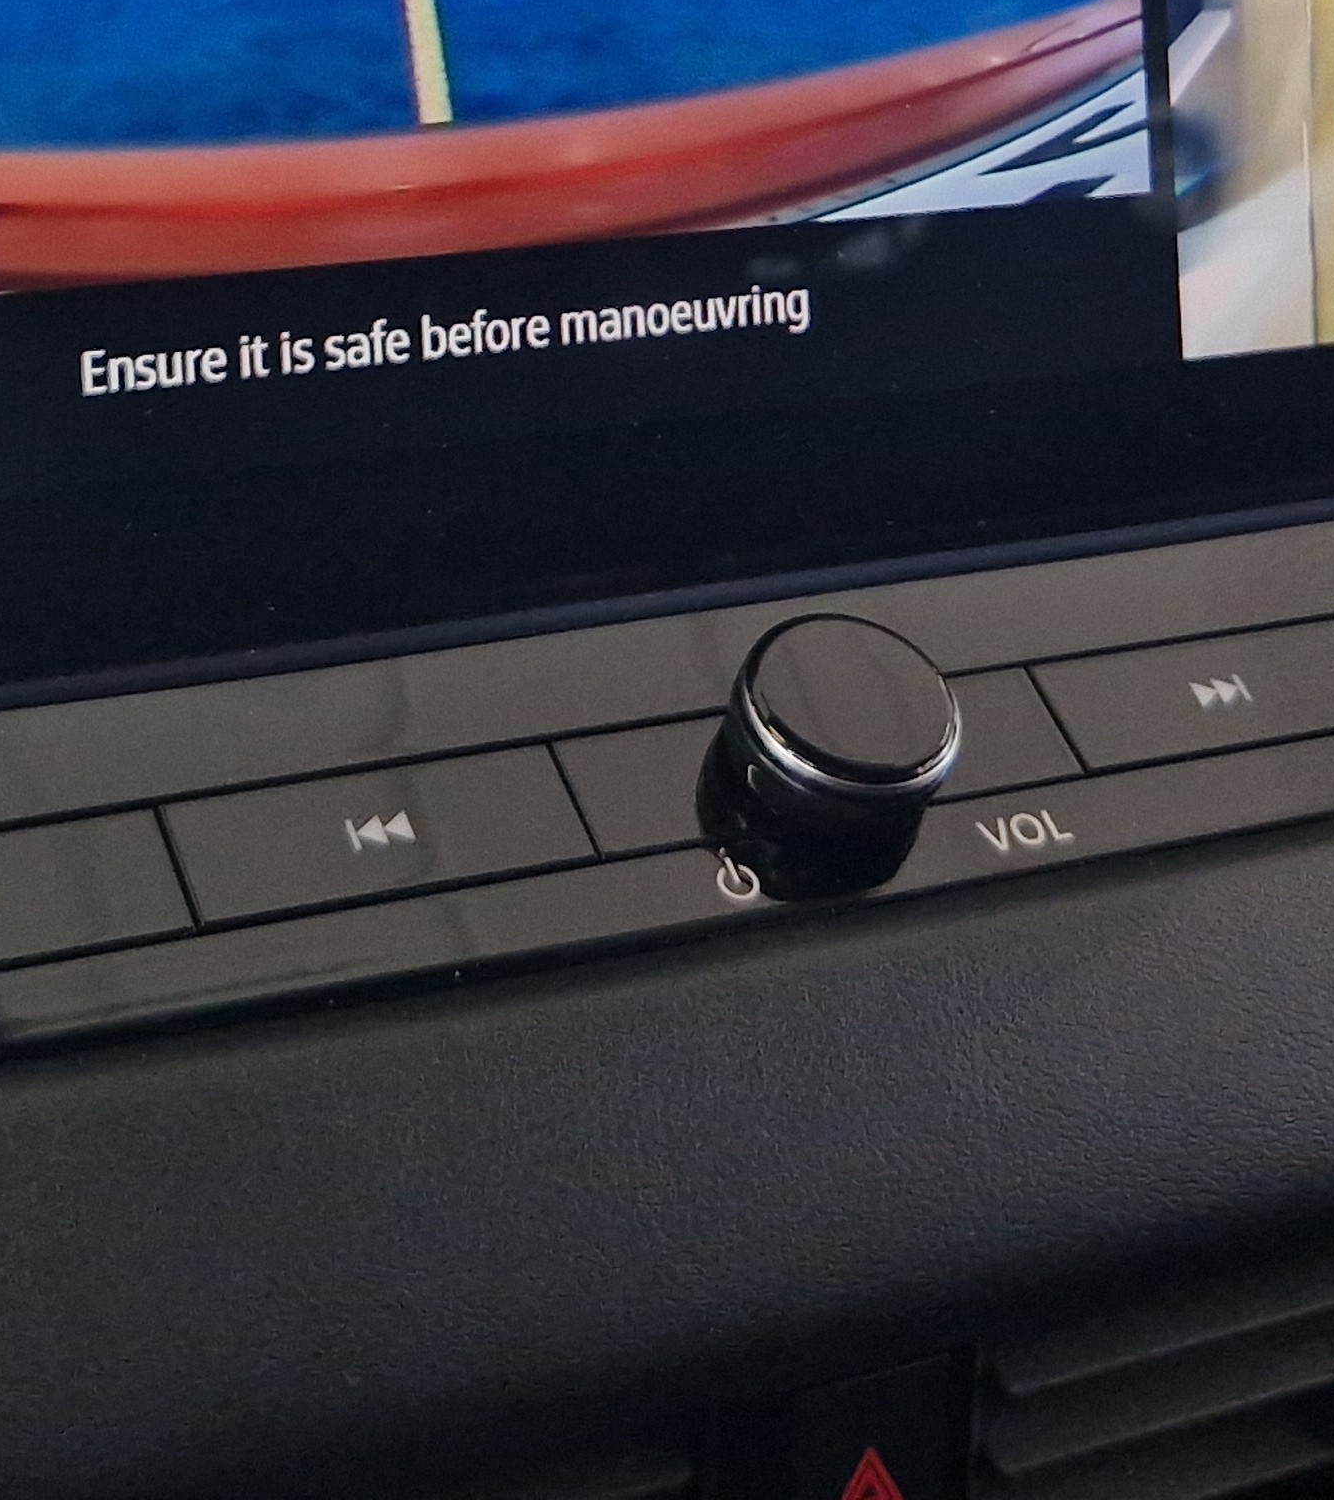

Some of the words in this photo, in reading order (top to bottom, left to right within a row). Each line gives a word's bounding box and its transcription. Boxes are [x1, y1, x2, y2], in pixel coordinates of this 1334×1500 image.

[80, 348, 228, 398] Ensure
[239, 334, 270, 380] it
[280, 330, 316, 376] is
[324, 317, 411, 371] safe
[421, 308, 551, 362] before
[561, 284, 810, 346] manoeuvring
[975, 809, 1075, 851] VOL
